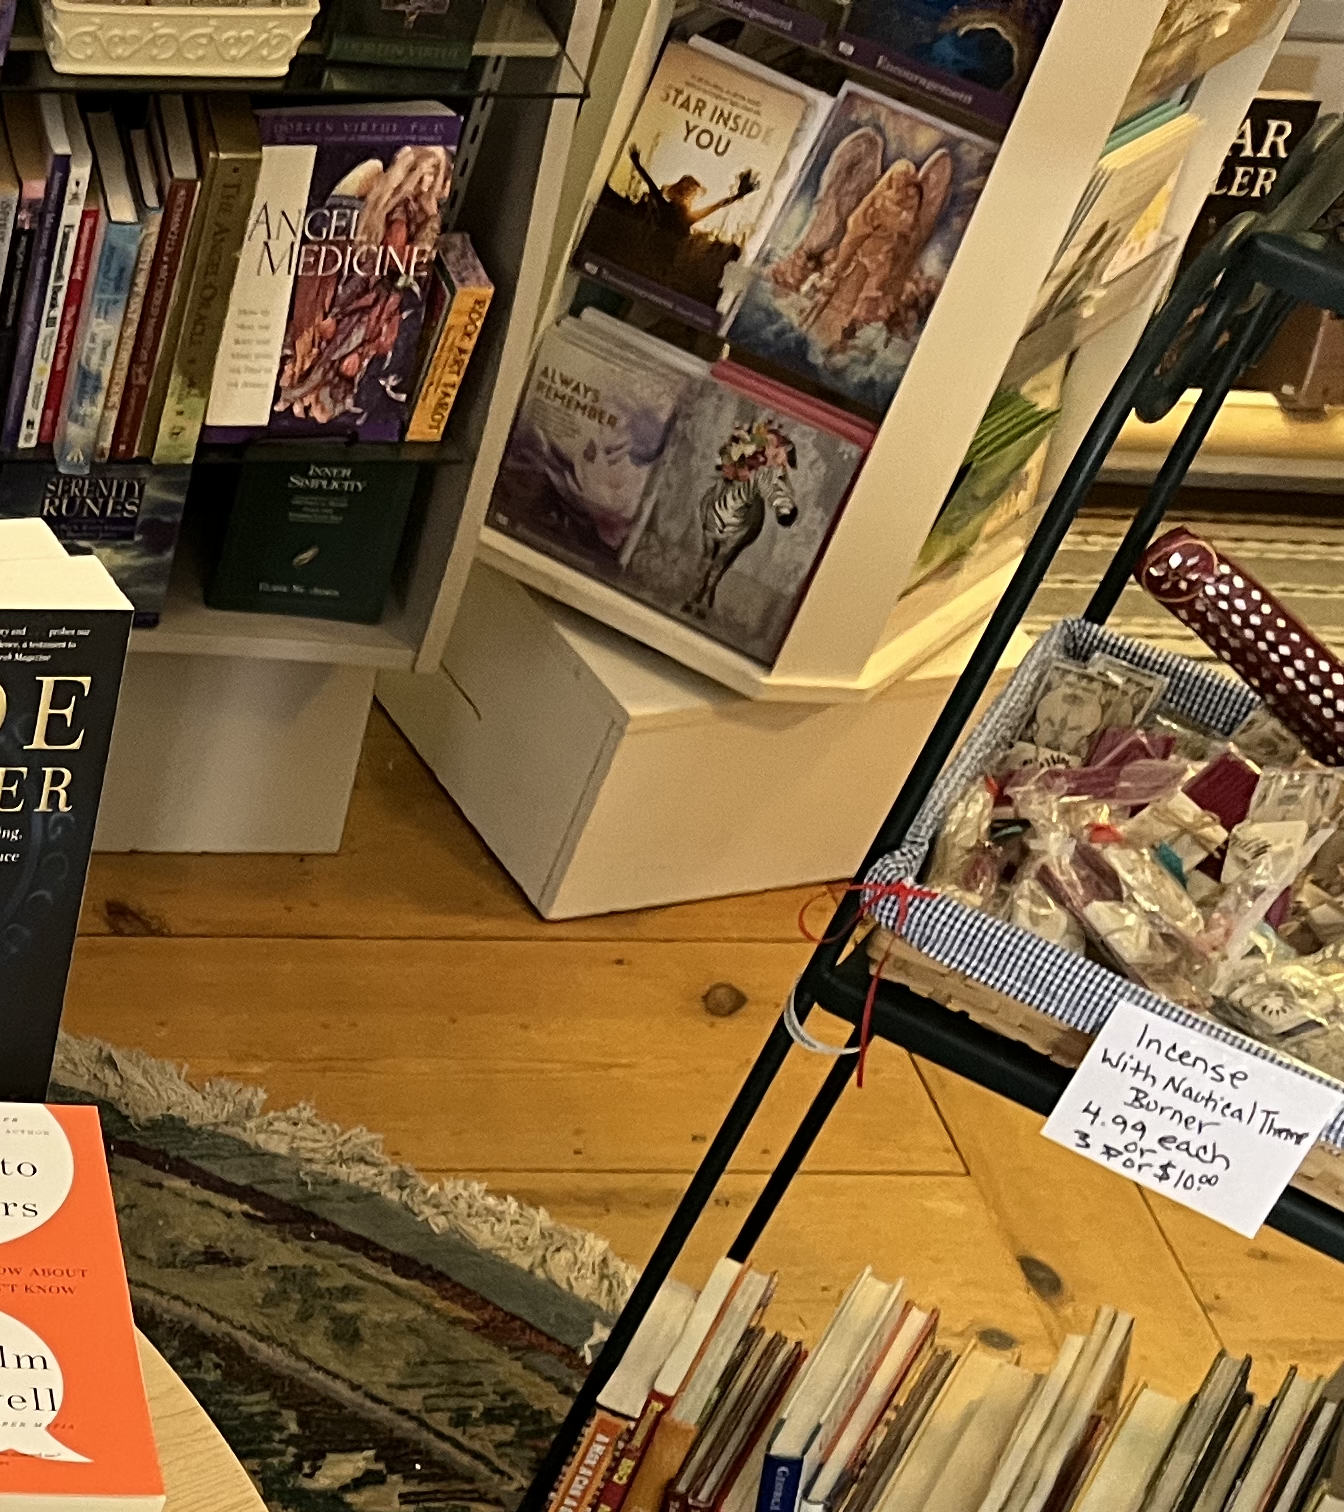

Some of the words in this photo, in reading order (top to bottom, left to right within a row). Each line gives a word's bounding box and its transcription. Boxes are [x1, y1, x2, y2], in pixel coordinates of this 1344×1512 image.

[248, 202, 360, 241] ANGEL
[257, 241, 429, 277] MEDICINE
[41, 496, 140, 521] RUNES
[1136, 1024, 1249, 1089] Incense
[1123, 1087, 1221, 1135] Burner
[1162, 1076, 1257, 1126] Nautical
[1074, 1129, 1091, 1149] 3
[1082, 1100, 1147, 1139] 4.99
[1158, 1134, 1230, 1170] each
[0, 1149, 37, 1178] to
